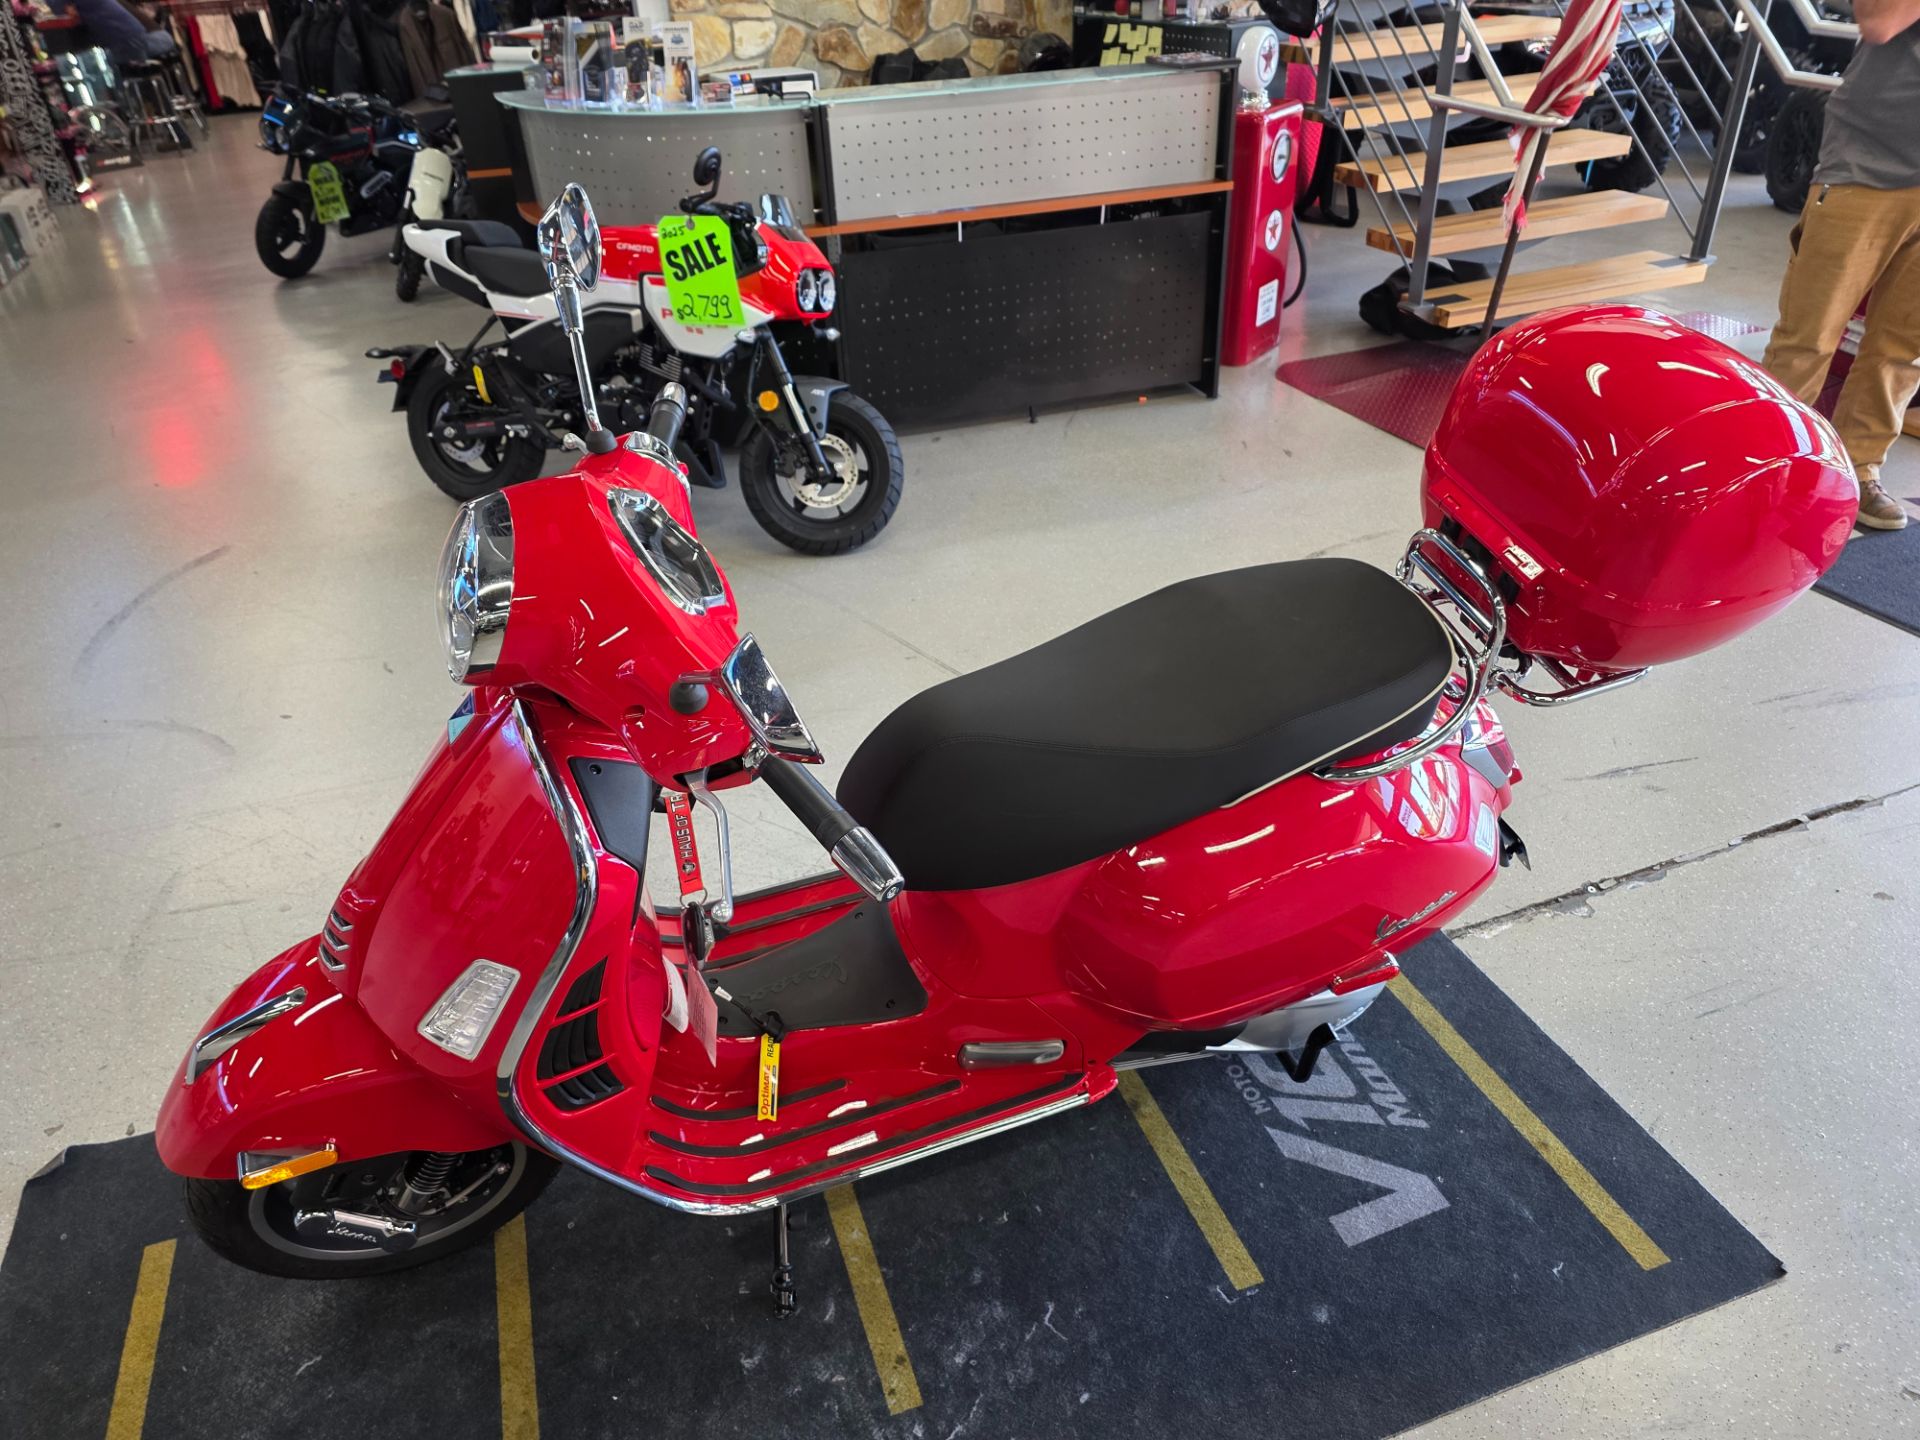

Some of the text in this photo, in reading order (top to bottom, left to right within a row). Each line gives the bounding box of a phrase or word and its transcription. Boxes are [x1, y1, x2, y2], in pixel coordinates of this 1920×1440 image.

[616, 242, 654, 253] CFMOTO
[665, 232, 727, 281] SALE
[675, 814, 688, 828] OF
[676, 828, 693, 858] HAUS
[1225, 1064, 1272, 1116] MOTO
